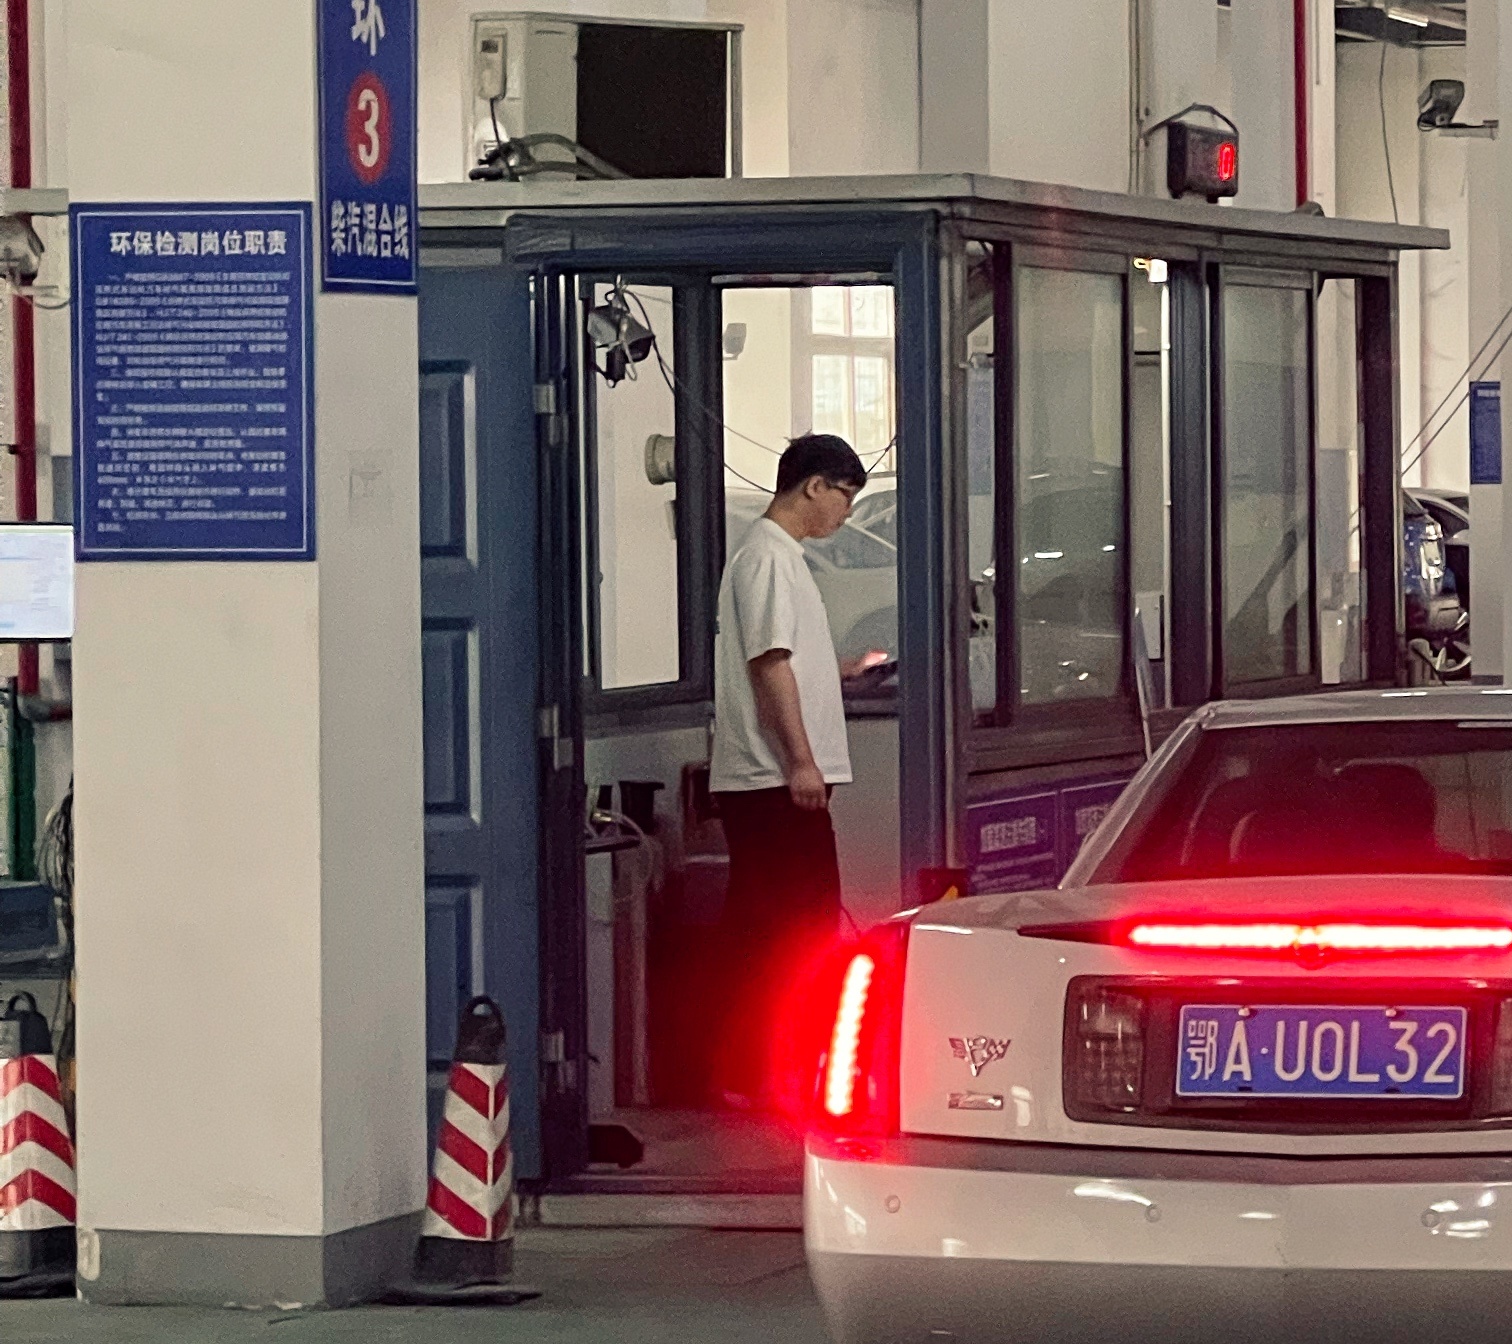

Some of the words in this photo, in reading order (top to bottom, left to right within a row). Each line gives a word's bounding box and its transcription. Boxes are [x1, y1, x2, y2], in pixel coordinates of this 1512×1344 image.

[357, 88, 379, 167] 3
[109, 229, 287, 256] 环保检测岗位职责
[330, 200, 410, 260] 柴汽混合线
